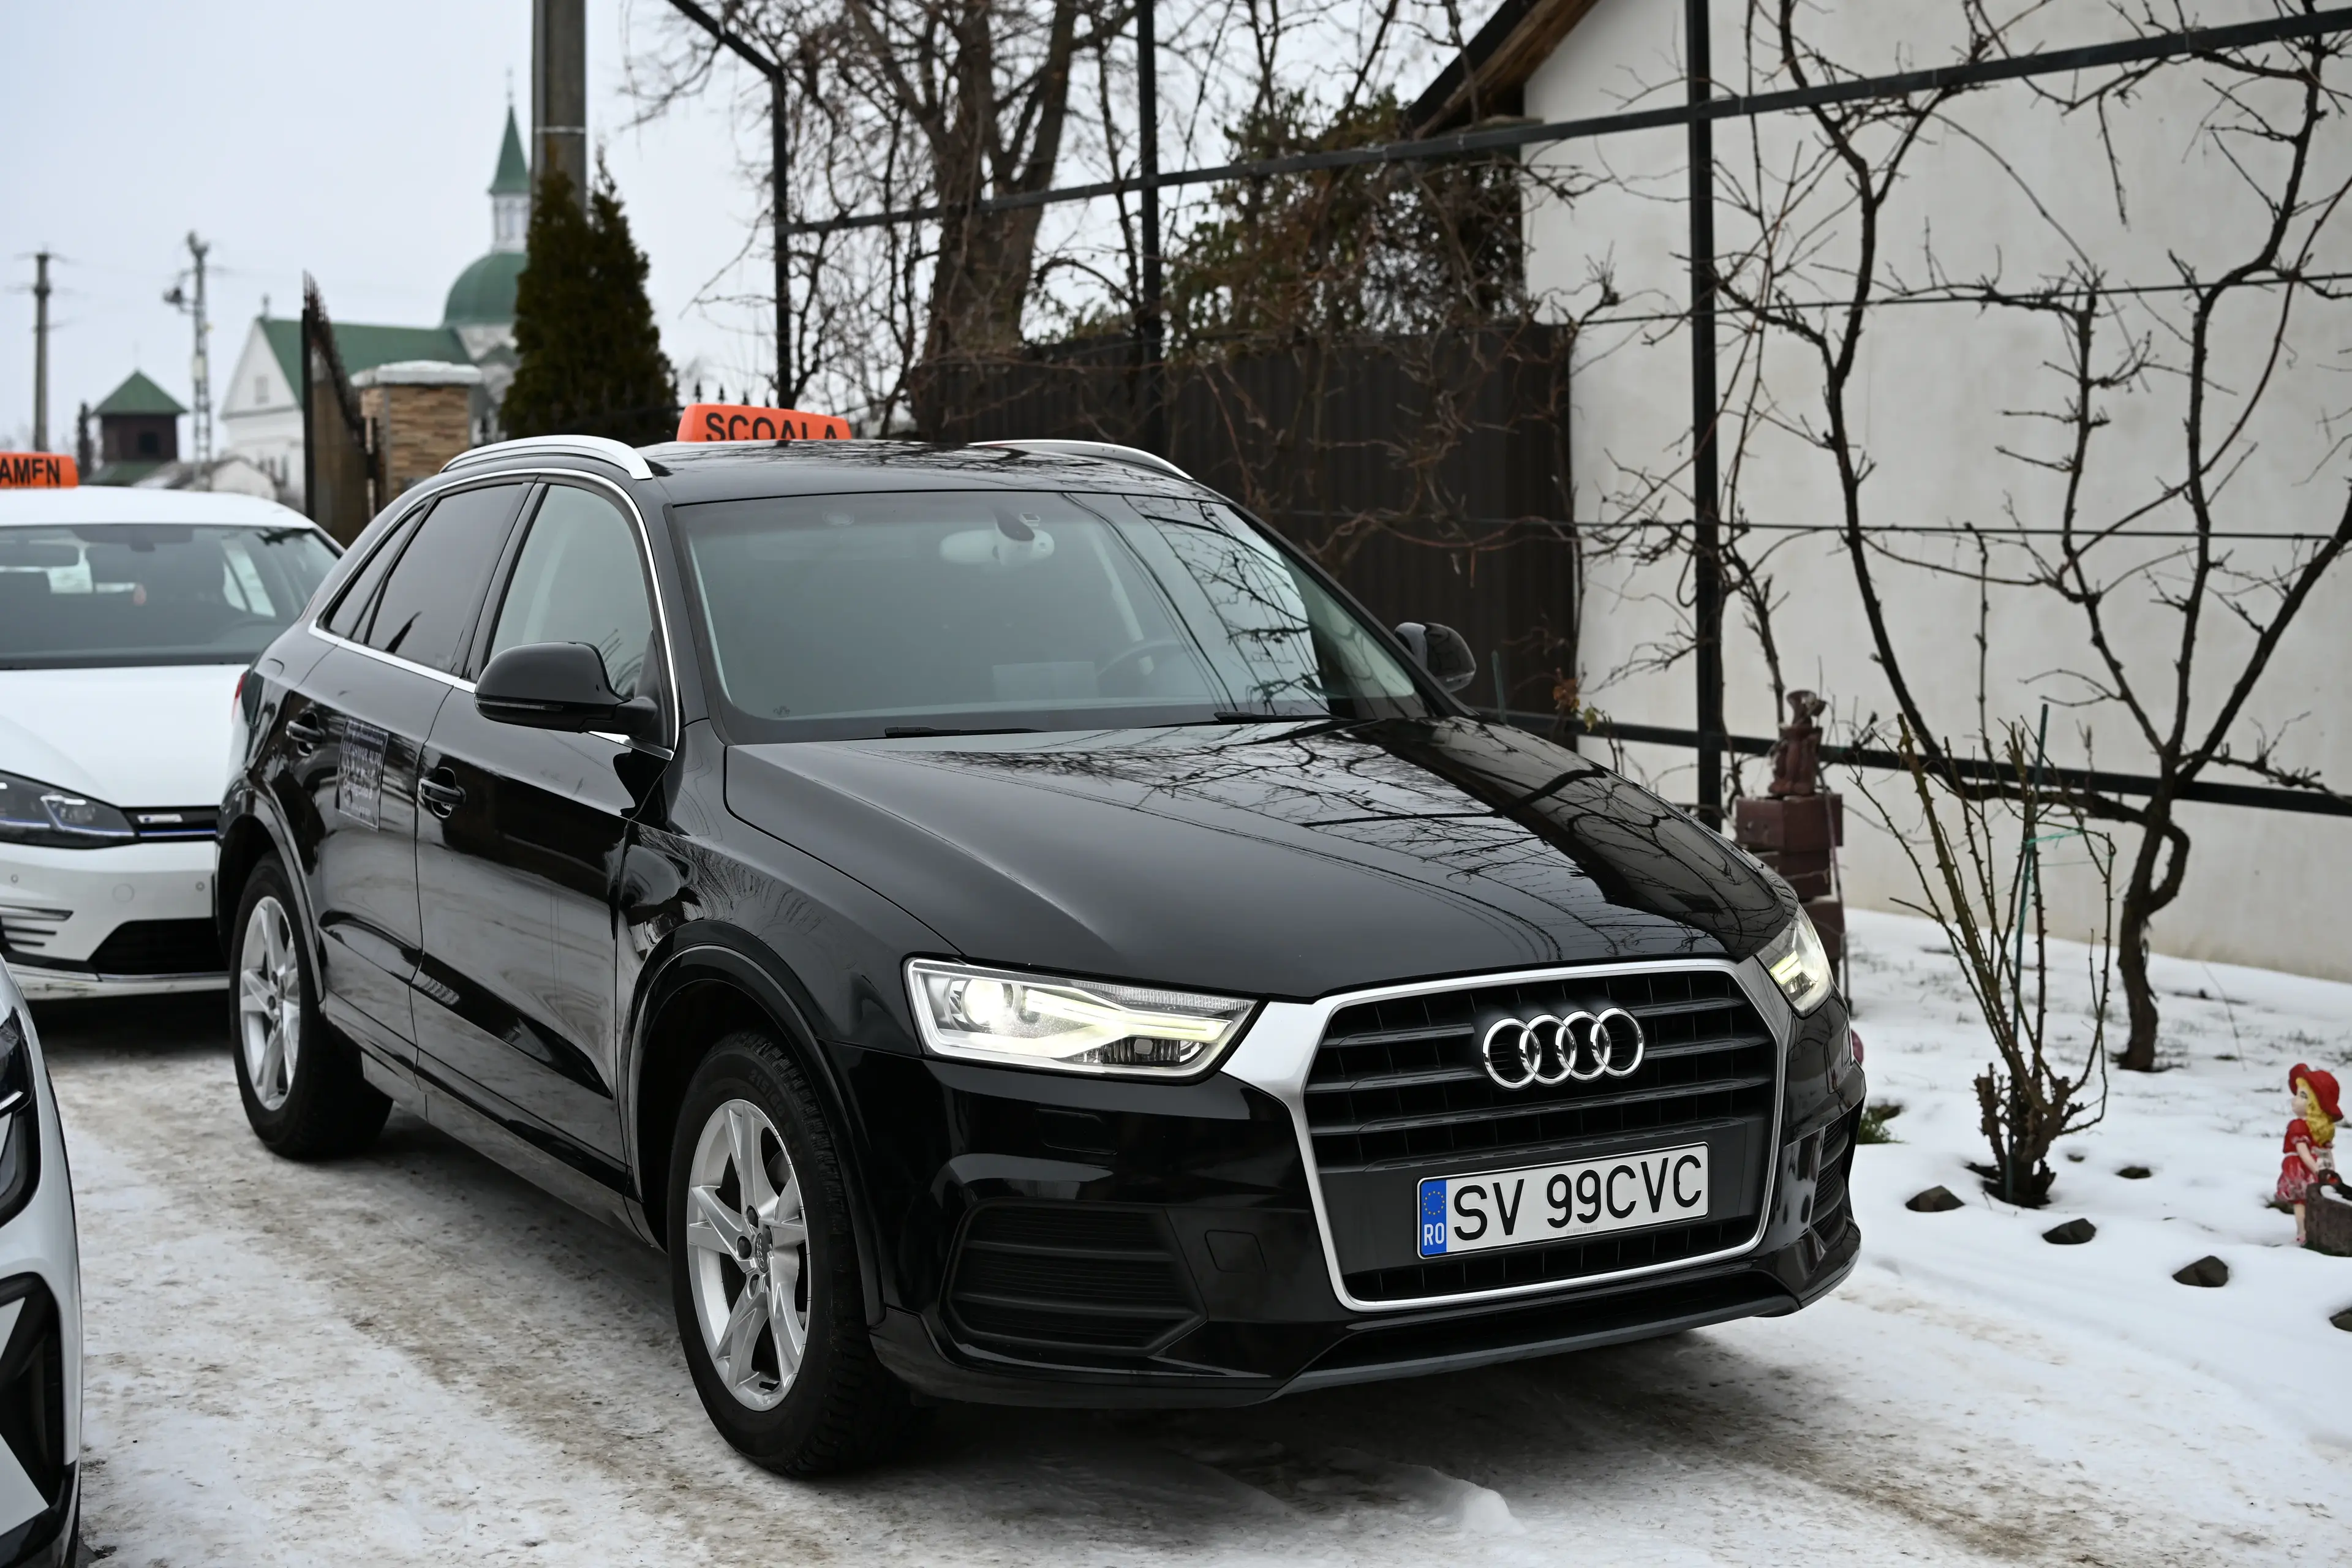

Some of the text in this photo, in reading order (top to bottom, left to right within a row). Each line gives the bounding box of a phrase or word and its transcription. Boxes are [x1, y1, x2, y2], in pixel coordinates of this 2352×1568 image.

[1453, 1155, 1702, 1240] SV 99CVC
[1423, 1223, 1444, 1246] RO
